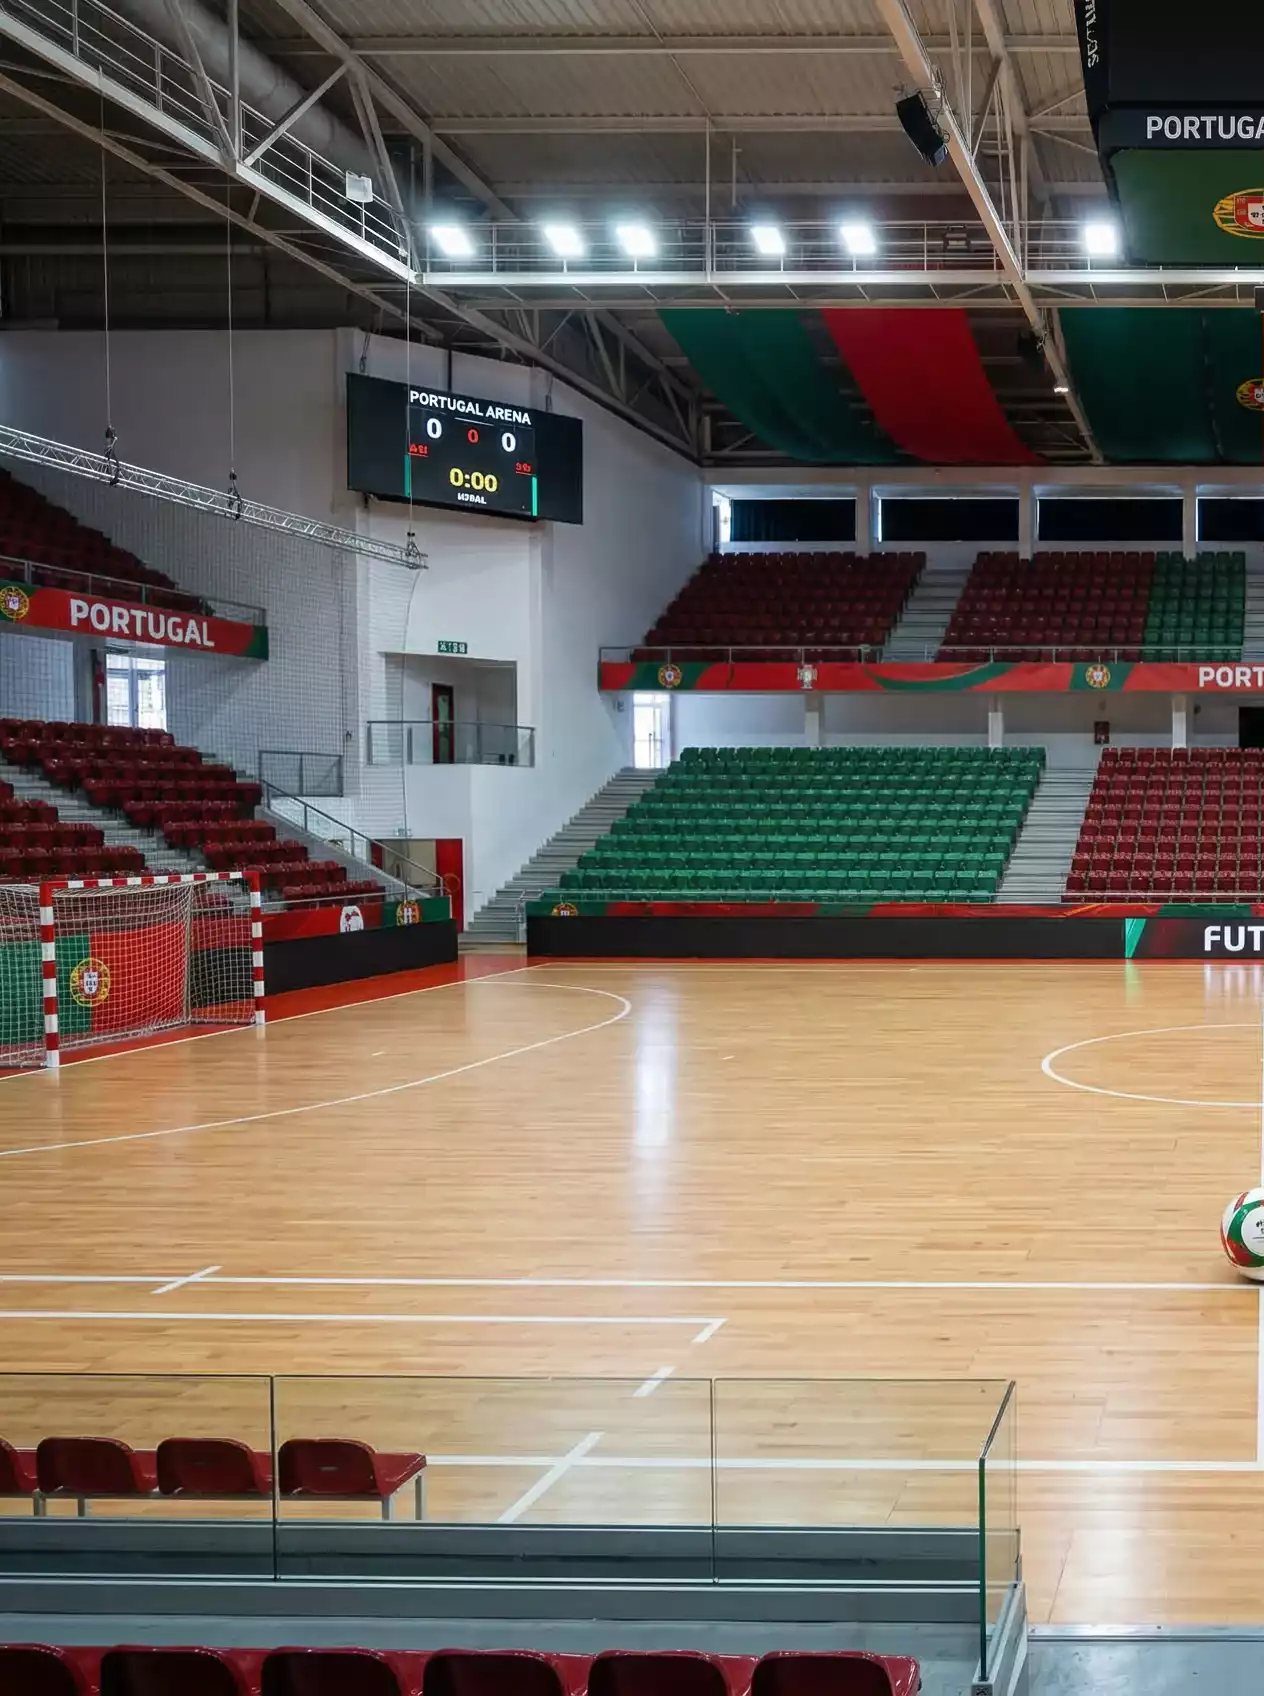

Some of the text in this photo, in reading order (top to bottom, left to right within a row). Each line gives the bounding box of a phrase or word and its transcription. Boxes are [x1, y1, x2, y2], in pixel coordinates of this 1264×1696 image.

[410, 390, 532, 426] PORTUGAL ARENA
[426, 417, 517, 453] 0 0 0
[449, 467, 499, 493] 0:00
[69, 598, 215, 647] PORTUGAL
